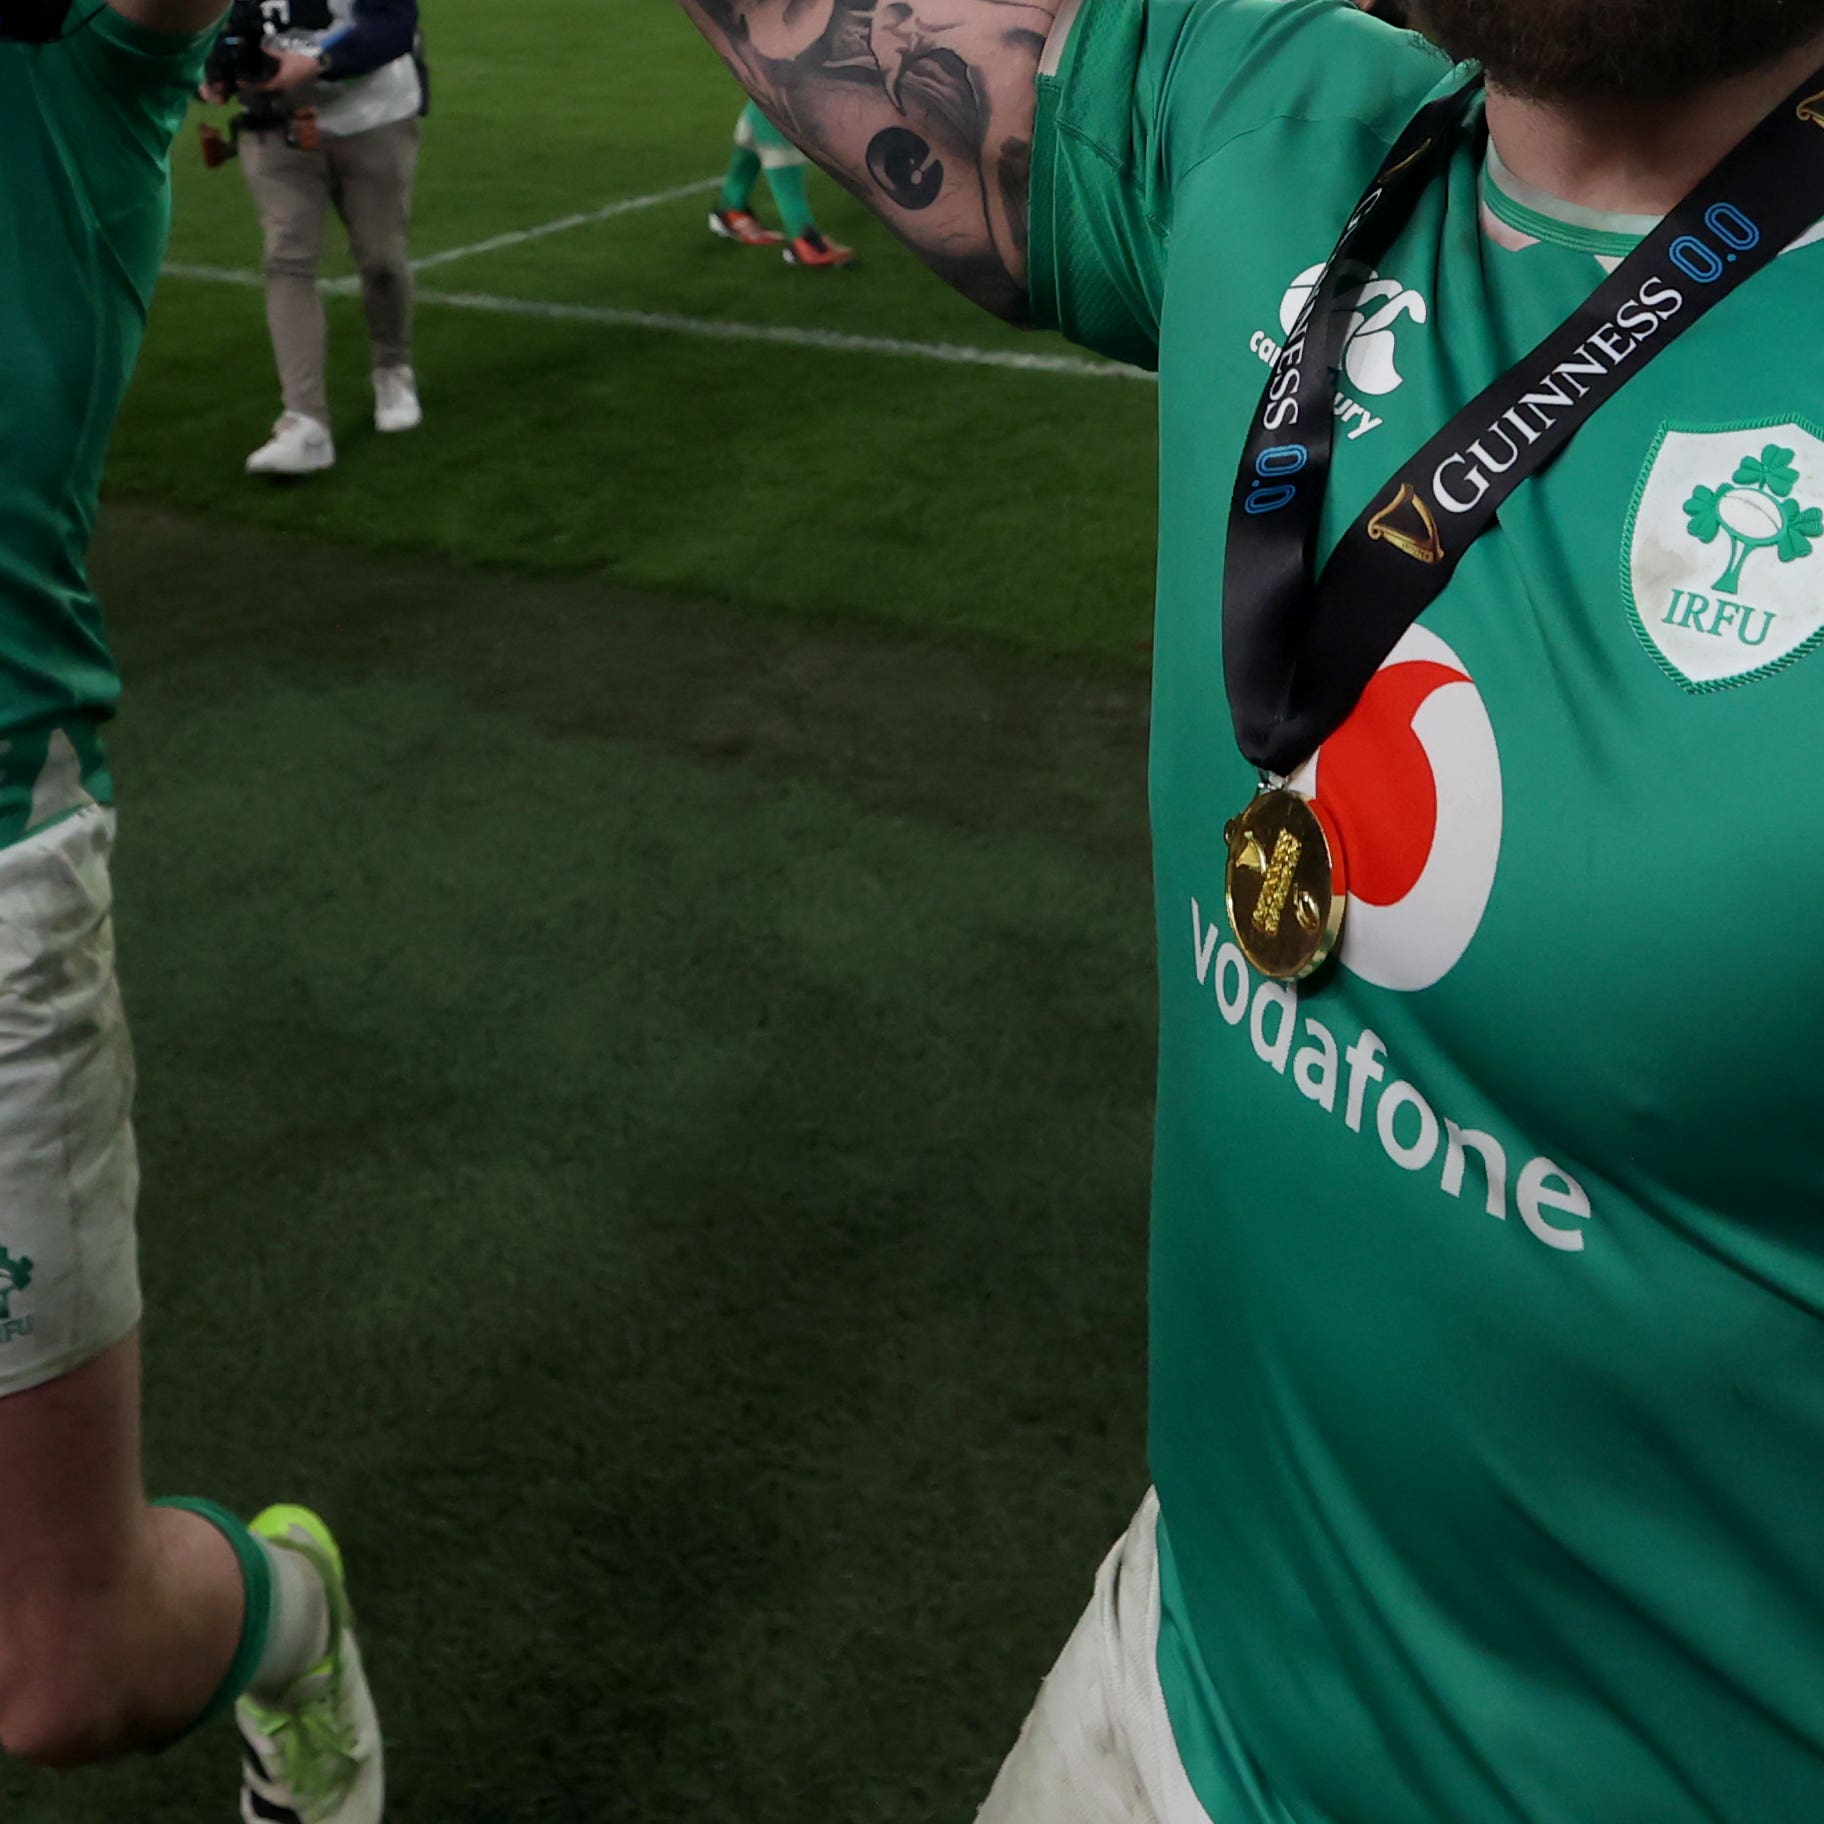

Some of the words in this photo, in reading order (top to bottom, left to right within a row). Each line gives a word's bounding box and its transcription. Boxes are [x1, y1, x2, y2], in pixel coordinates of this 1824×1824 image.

[1432, 276, 1683, 514] GUINNESS
[1668, 202, 1760, 283] 0.0
[1245, 443, 1308, 514] 0.0
[1662, 588, 1776, 645] IRFU
[1190, 895, 1592, 1253] vodafone
